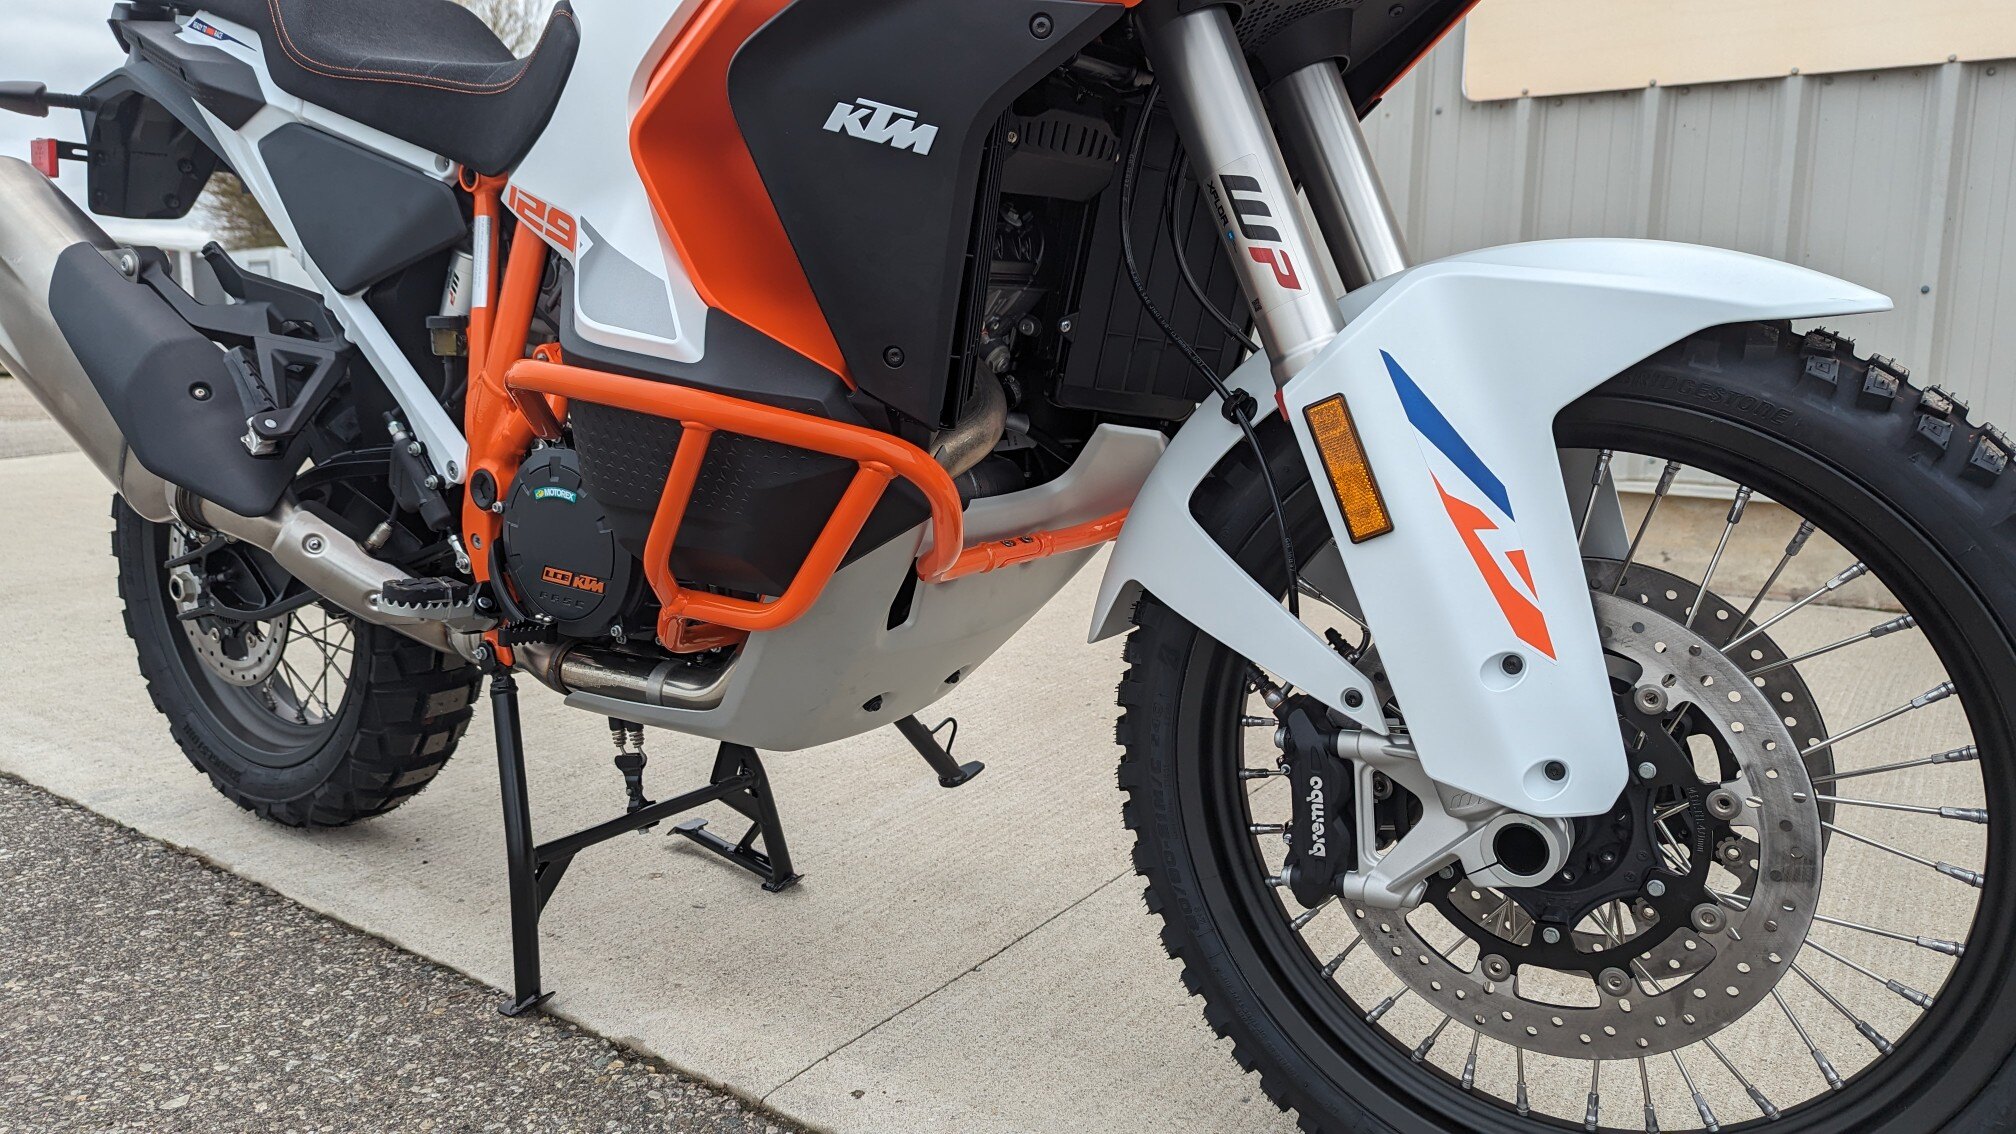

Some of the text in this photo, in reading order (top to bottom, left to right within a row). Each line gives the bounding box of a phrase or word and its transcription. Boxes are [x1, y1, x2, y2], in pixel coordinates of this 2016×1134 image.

[822, 97, 939, 156] KTM
[508, 184, 576, 254] 129
[1218, 174, 1302, 290] WP
[543, 488, 575, 501] MOTOREX
[572, 575, 606, 594] KTM
[1306, 776, 1326, 857] brembo
